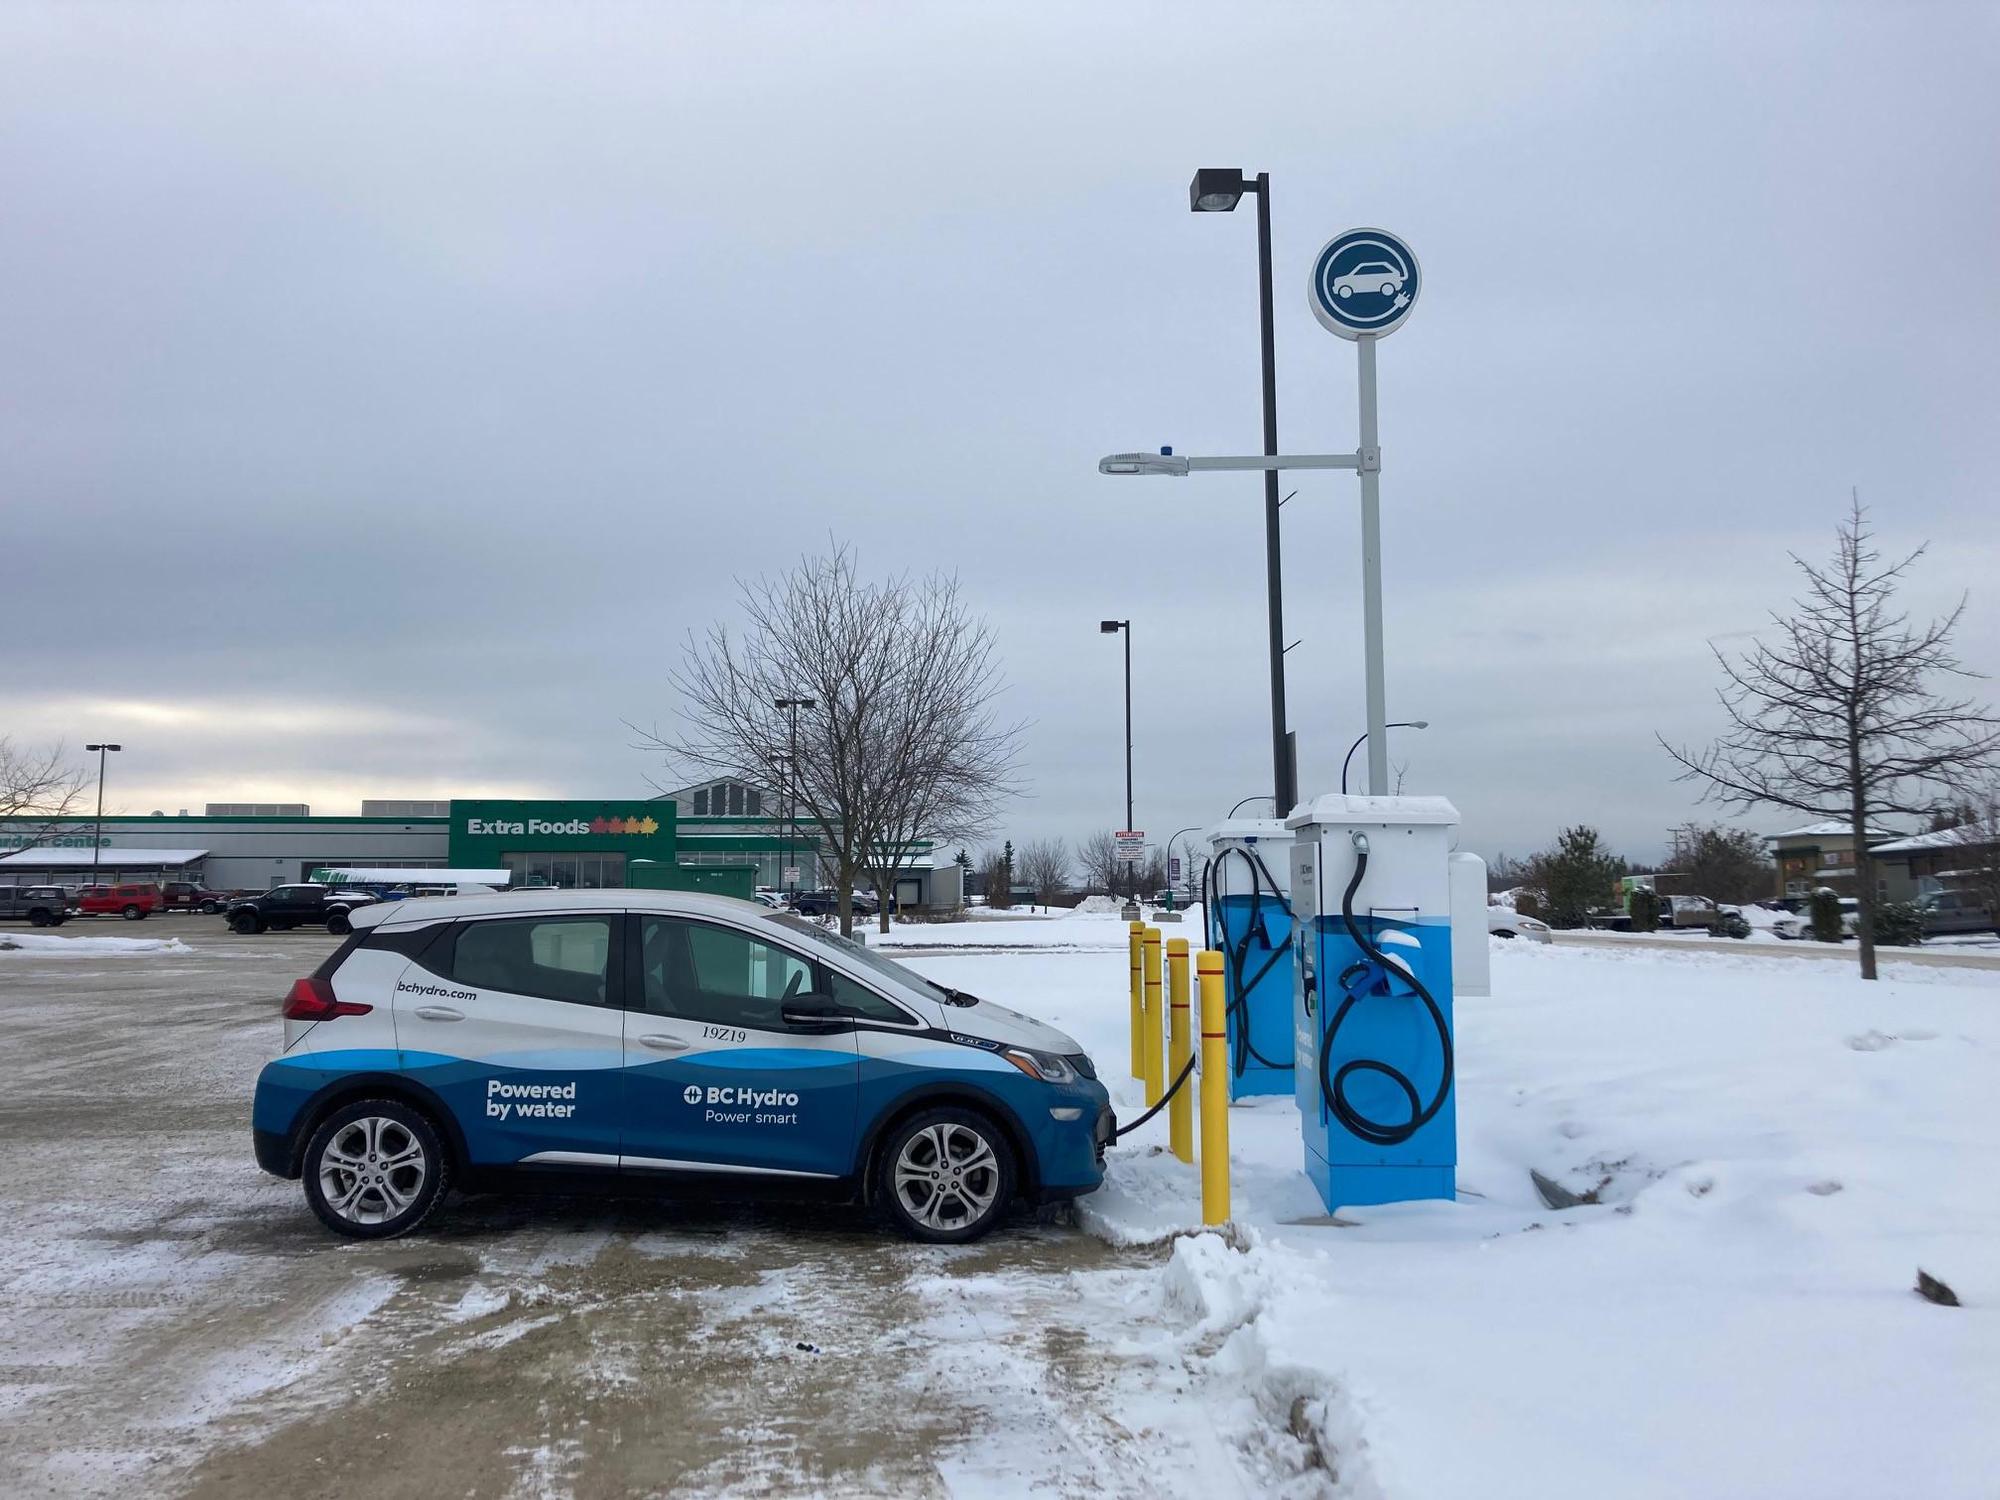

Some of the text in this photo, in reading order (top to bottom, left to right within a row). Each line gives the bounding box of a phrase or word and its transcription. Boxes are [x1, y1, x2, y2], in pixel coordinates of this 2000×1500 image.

[467, 819, 590, 835] Extra Foods
[397, 981, 477, 1001] bchydro.com
[703, 1026, 746, 1043] 19Z19
[487, 1080, 576, 1099] Powered
[706, 1087, 799, 1109] BC Hydro
[486, 1099, 576, 1120] by water
[705, 1109, 797, 1125] Power smart
